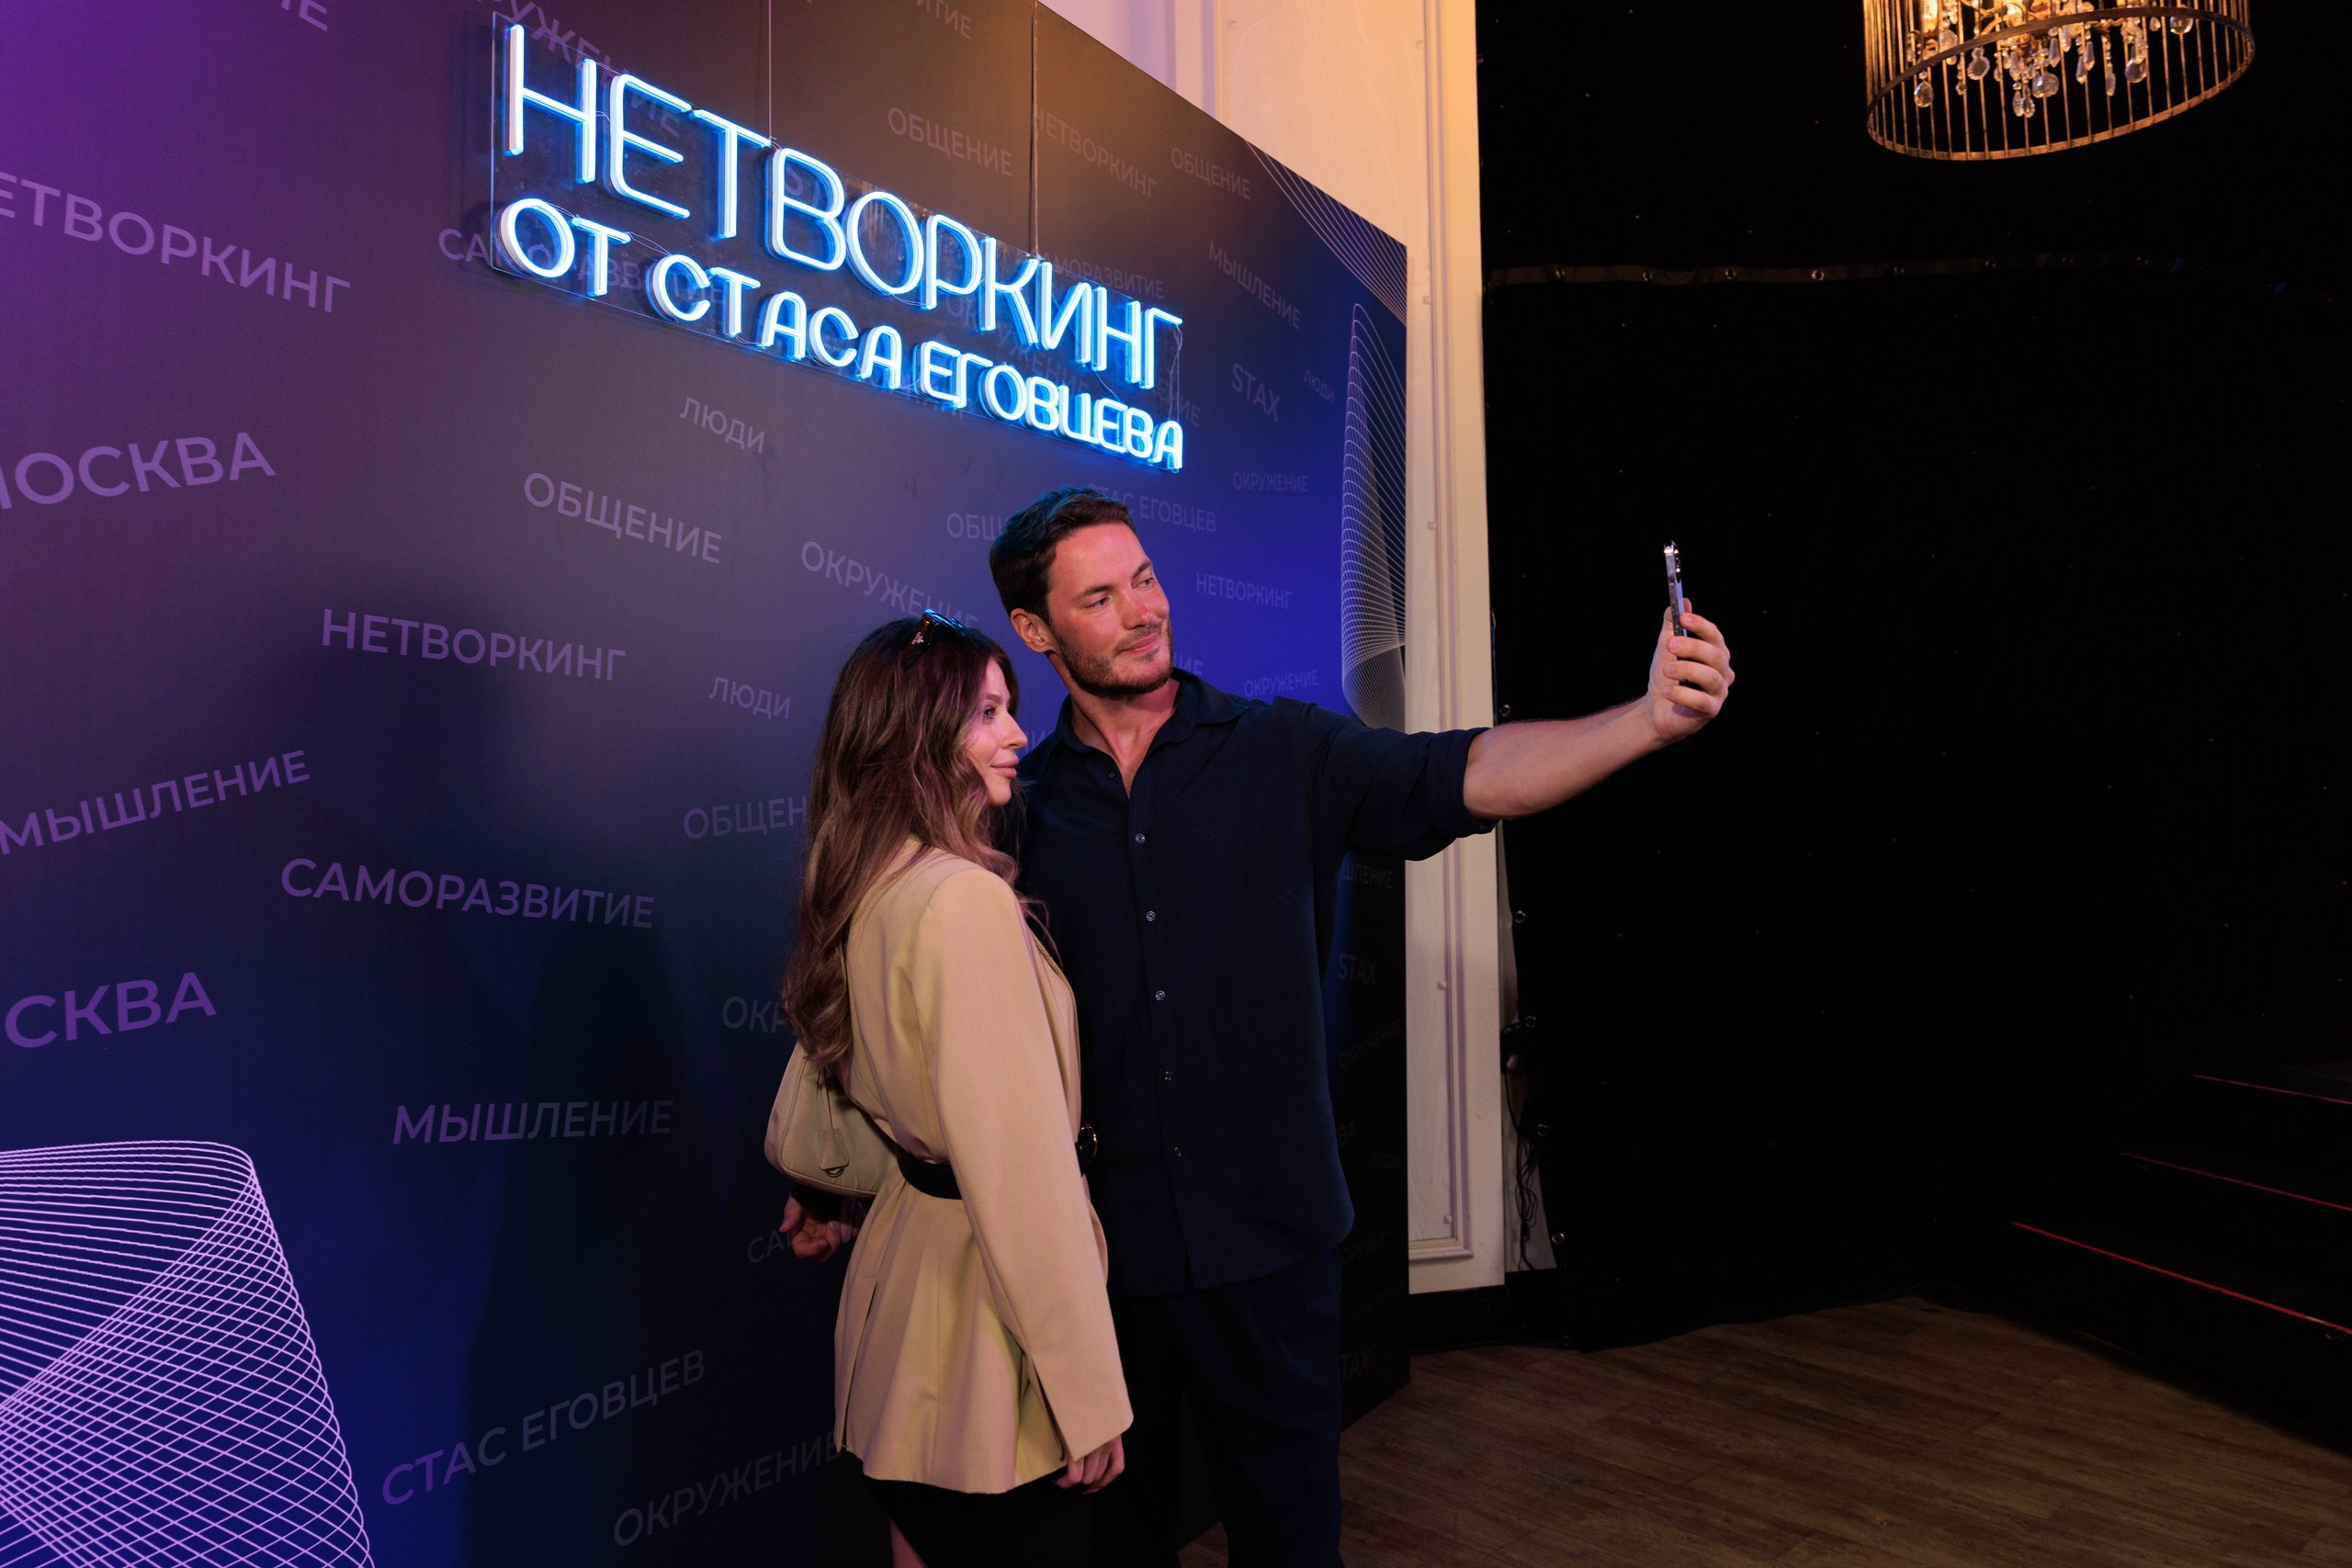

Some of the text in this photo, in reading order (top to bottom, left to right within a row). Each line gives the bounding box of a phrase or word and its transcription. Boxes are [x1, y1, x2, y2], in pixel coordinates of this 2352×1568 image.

[888, 107, 1014, 177] ОБЩЕНИЕ
[1171, 147, 1252, 200] ОБЩЕНИЕ
[502, 23, 1184, 390] НЕТВОРКИНГ
[1209, 240, 1301, 331] МЫШЛЕНИЕ
[496, 197, 1185, 470] ОТ СТАСА ЕГОВЦЕВА
[1231, 362, 1281, 423] STAX
[1303, 368, 1336, 405] ЛЮДИ
[680, 397, 766, 453] ЛЮДИ
[1233, 470, 1309, 493] ОКРУЖЕНИЕ
[523, 471, 723, 565] ОБЩЕНИЕ
[1140, 496, 1218, 535] ЕГОВЦЕВ
[1196, 570, 1293, 610] НЕТВОРКИНГ
[322, 608, 627, 681] НЕТВОРКИНГ
[708, 676, 791, 720] ЛЮДИ
[1244, 669, 1319, 699] ОКРУЖЕНИЕ
[0, 750, 311, 853] МЫШЛЕНИЕ
[281, 858, 655, 929] САМОРАЗВИТИЕ
[5, 972, 218, 1048] СКВА
[393, 1100, 673, 1145] МЫШЛЕНИЕ
[381, 1349, 706, 1505] СТАС ЕГОВЦЕВ
